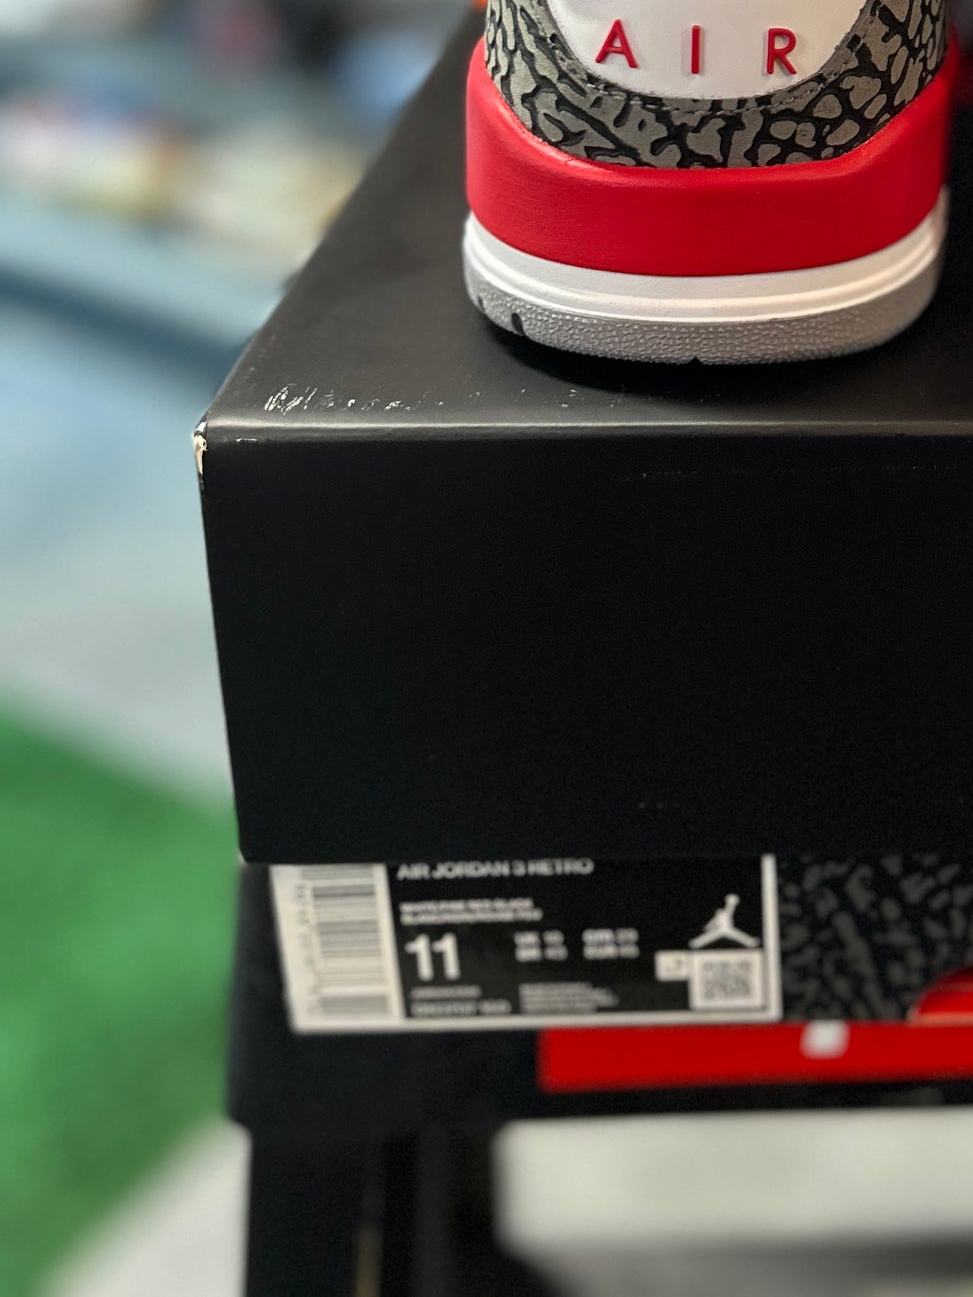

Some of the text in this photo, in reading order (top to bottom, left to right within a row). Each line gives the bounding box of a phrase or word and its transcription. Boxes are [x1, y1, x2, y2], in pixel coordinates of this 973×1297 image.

[595, 19, 798, 75] AIR
[397, 863, 430, 880] AIR
[432, 860, 510, 879] JORDAN
[527, 857, 594, 876] RETRO
[404, 931, 461, 982] 11
